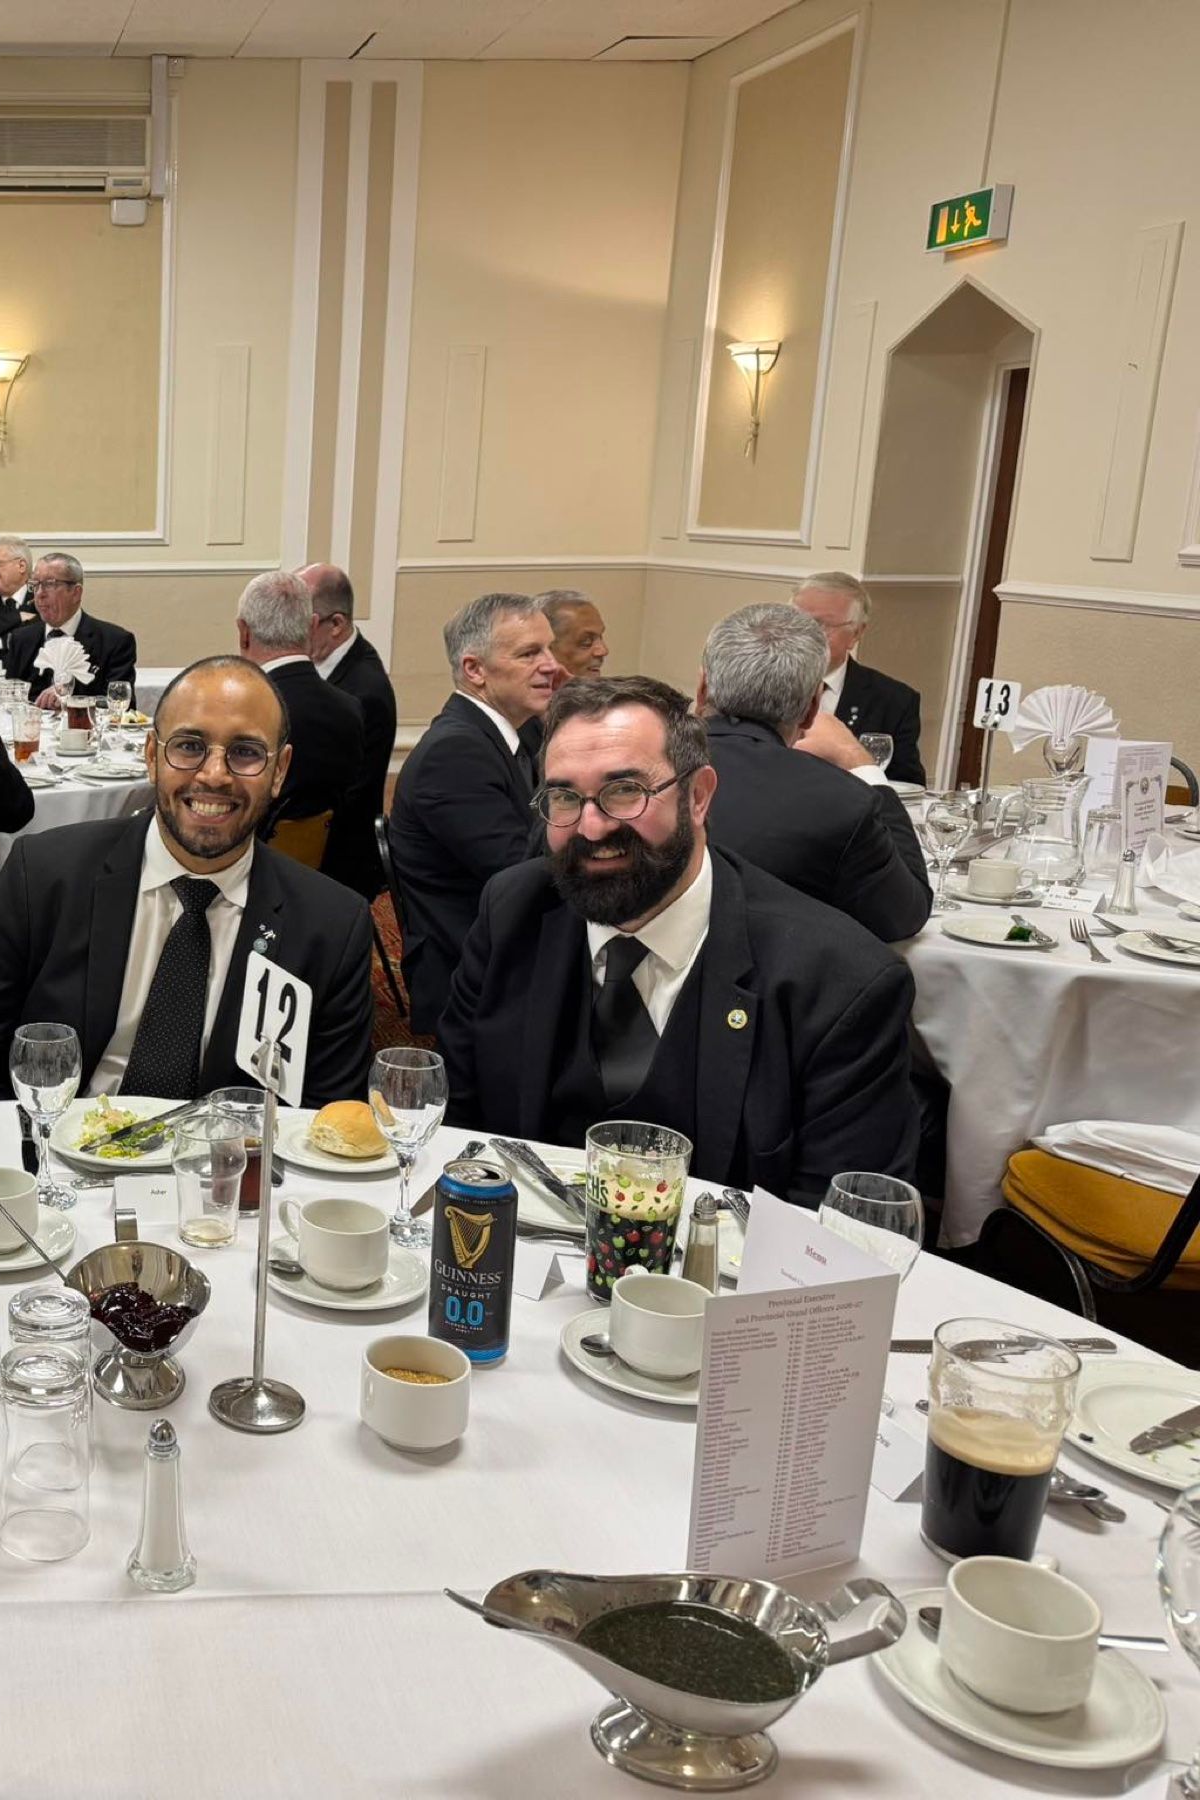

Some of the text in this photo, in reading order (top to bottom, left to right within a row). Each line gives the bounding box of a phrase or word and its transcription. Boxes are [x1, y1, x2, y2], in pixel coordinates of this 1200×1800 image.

[984, 682, 1010, 717] 13
[255, 967, 298, 1064] 12
[804, 1244, 828, 1266] Menu
[434, 1259, 503, 1284] GUINNESS
[441, 1283, 492, 1299] DRAUGHT
[767, 1296, 802, 1308] Provincial
[445, 1295, 484, 1326] 0.0
[735, 1315, 749, 1325] and
[750, 1310, 786, 1323] Provincial
